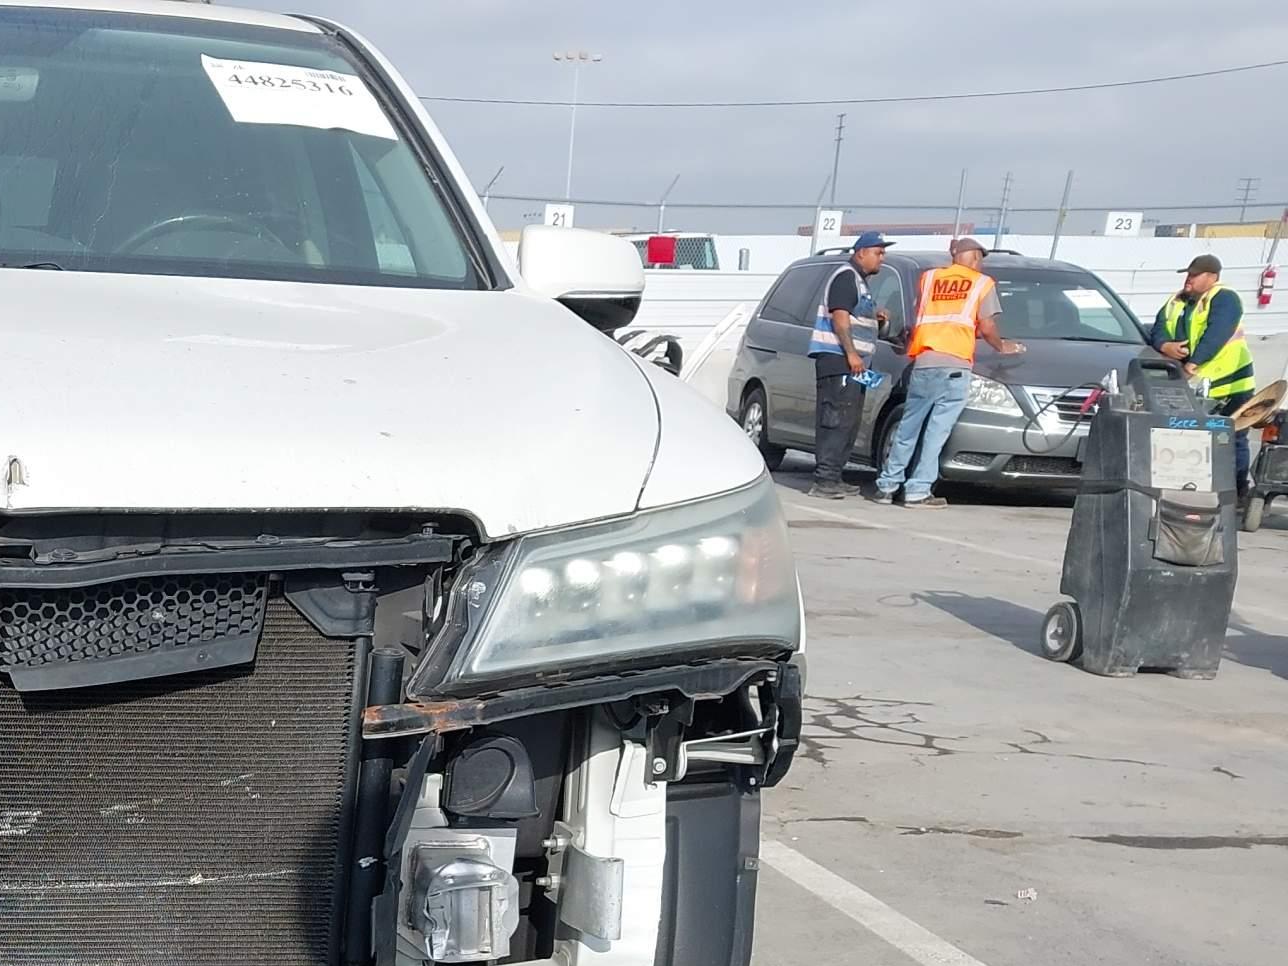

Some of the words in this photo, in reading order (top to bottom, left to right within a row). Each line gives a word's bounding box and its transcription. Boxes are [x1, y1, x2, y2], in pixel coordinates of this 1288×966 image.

[227, 73, 354, 97] 44825316
[552, 212, 566, 227] 21
[823, 217, 836, 231] 22
[1114, 217, 1133, 231] 23
[933, 279, 973, 294] MAD
